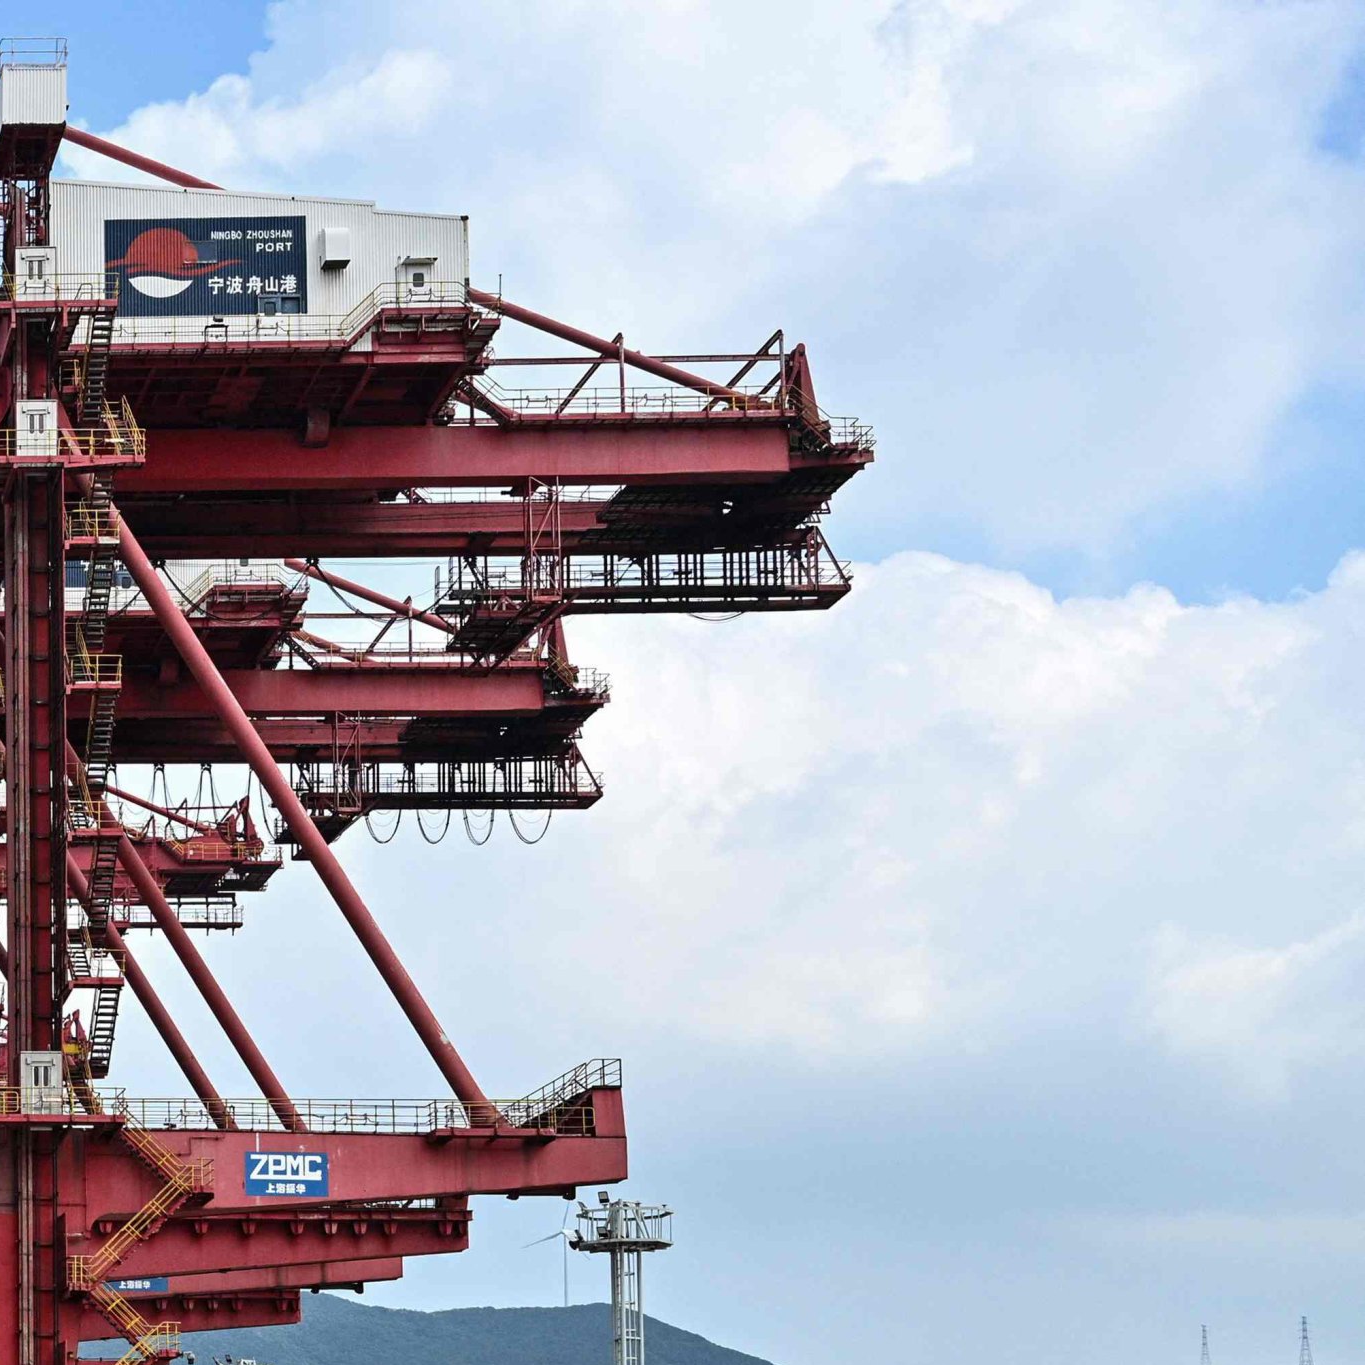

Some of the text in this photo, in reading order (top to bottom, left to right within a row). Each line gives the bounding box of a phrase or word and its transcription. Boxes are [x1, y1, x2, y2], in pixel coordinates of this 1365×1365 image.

[211, 230, 292, 240] NINGBO ZHOUSHAN
[256, 242, 292, 252] PORT
[208, 275, 297, 295] 宁波舟山港
[249, 1153, 322, 1181] ZPMC
